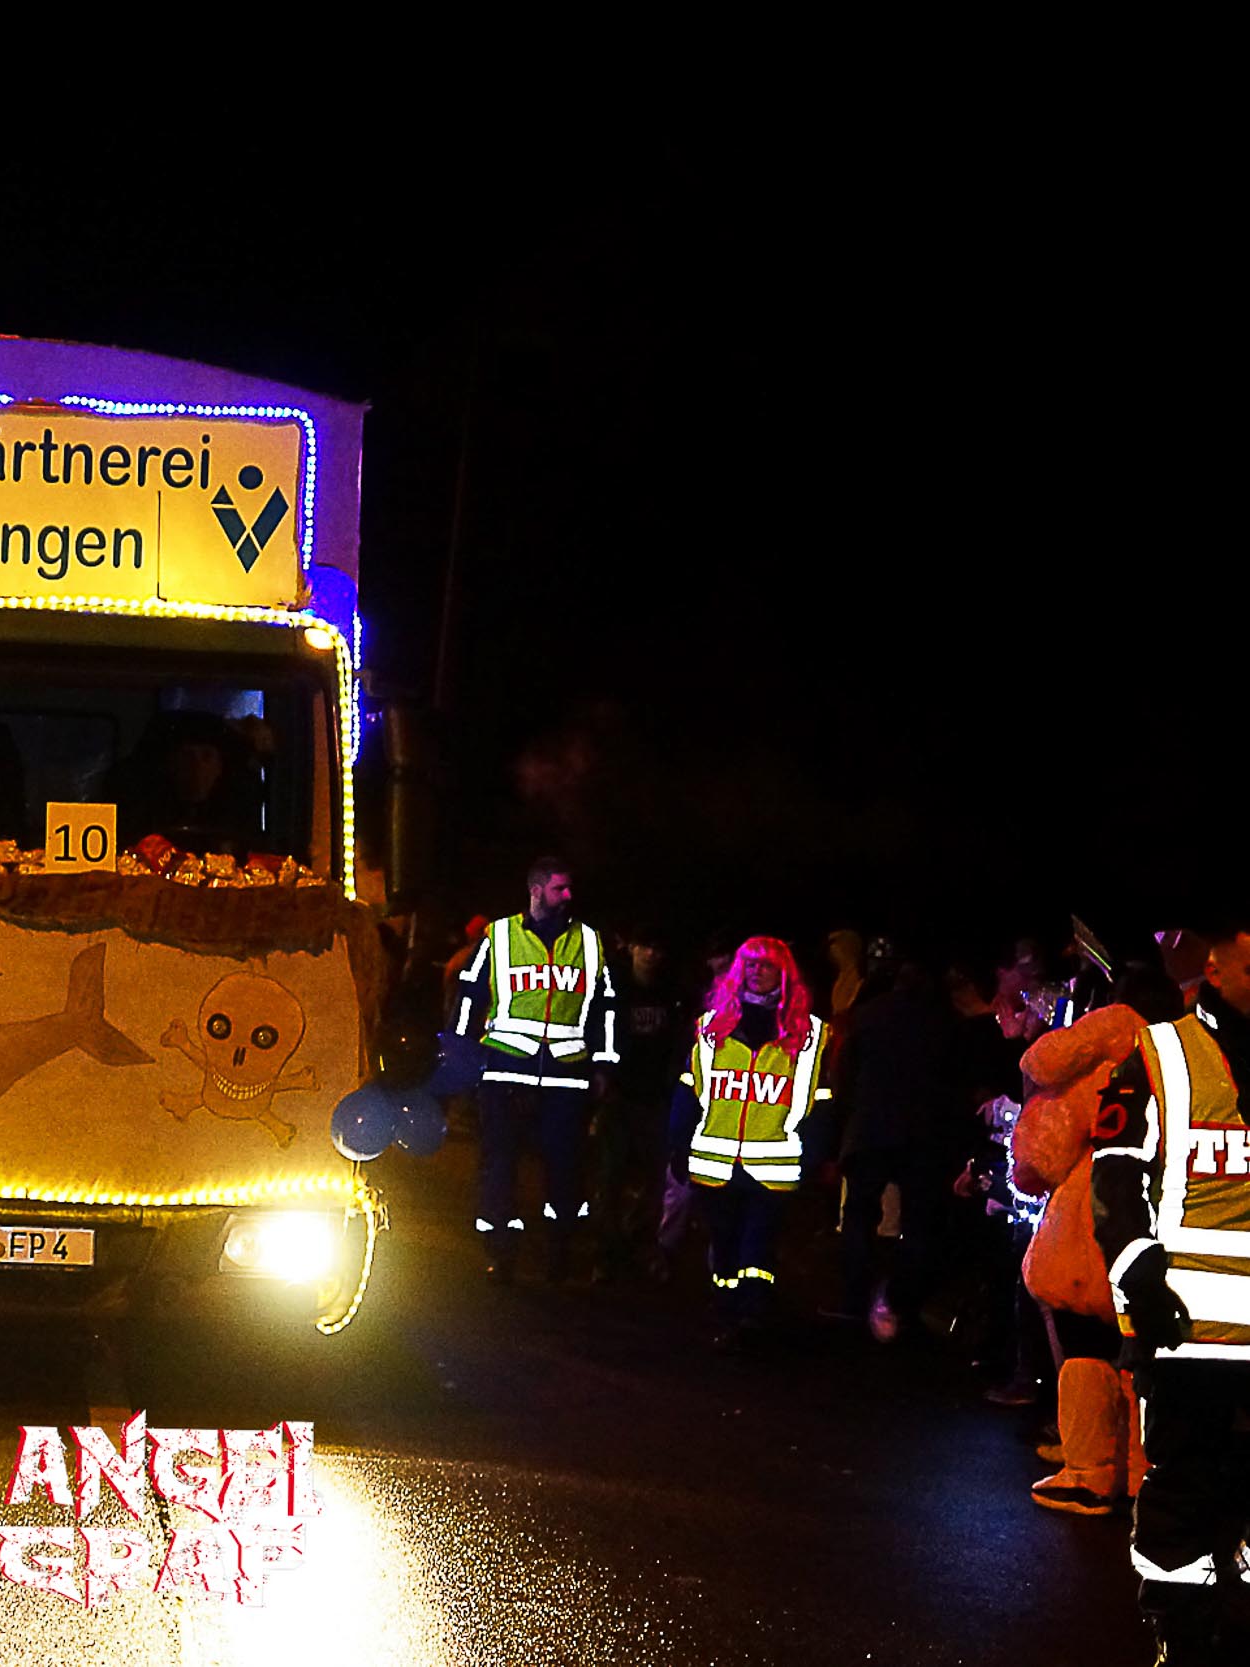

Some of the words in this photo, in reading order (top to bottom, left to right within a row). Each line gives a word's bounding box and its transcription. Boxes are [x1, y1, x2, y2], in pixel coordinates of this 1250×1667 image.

[54, 824, 108, 863] 10
[508, 964, 580, 992] THW
[710, 1069, 788, 1105] THW
[9, 1232, 46, 1259] FP
[53, 1234, 68, 1260] 4
